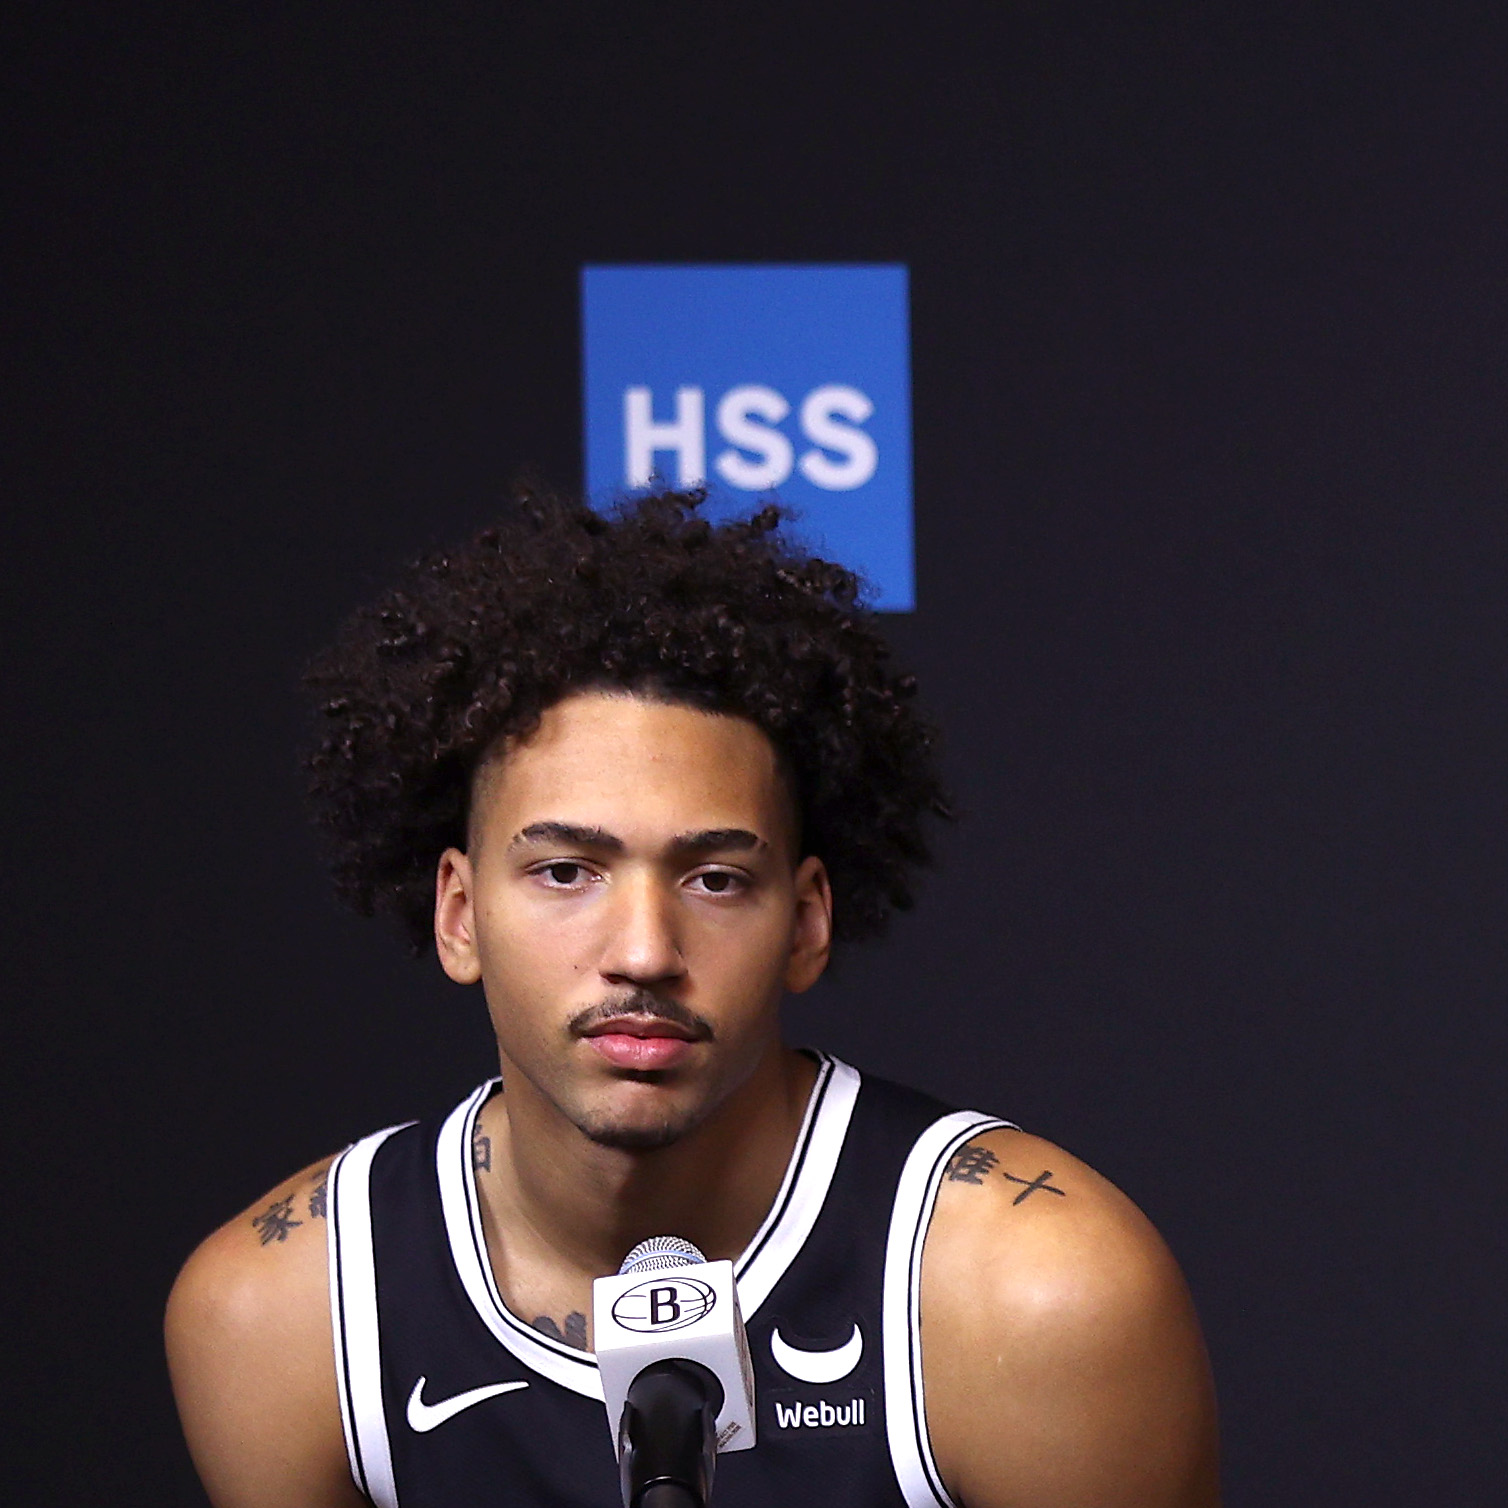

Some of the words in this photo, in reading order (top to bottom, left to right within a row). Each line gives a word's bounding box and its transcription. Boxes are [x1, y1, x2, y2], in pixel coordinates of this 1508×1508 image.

[624, 383, 879, 491] HSS
[650, 1287, 681, 1326] B
[774, 1398, 866, 1430] Webull
